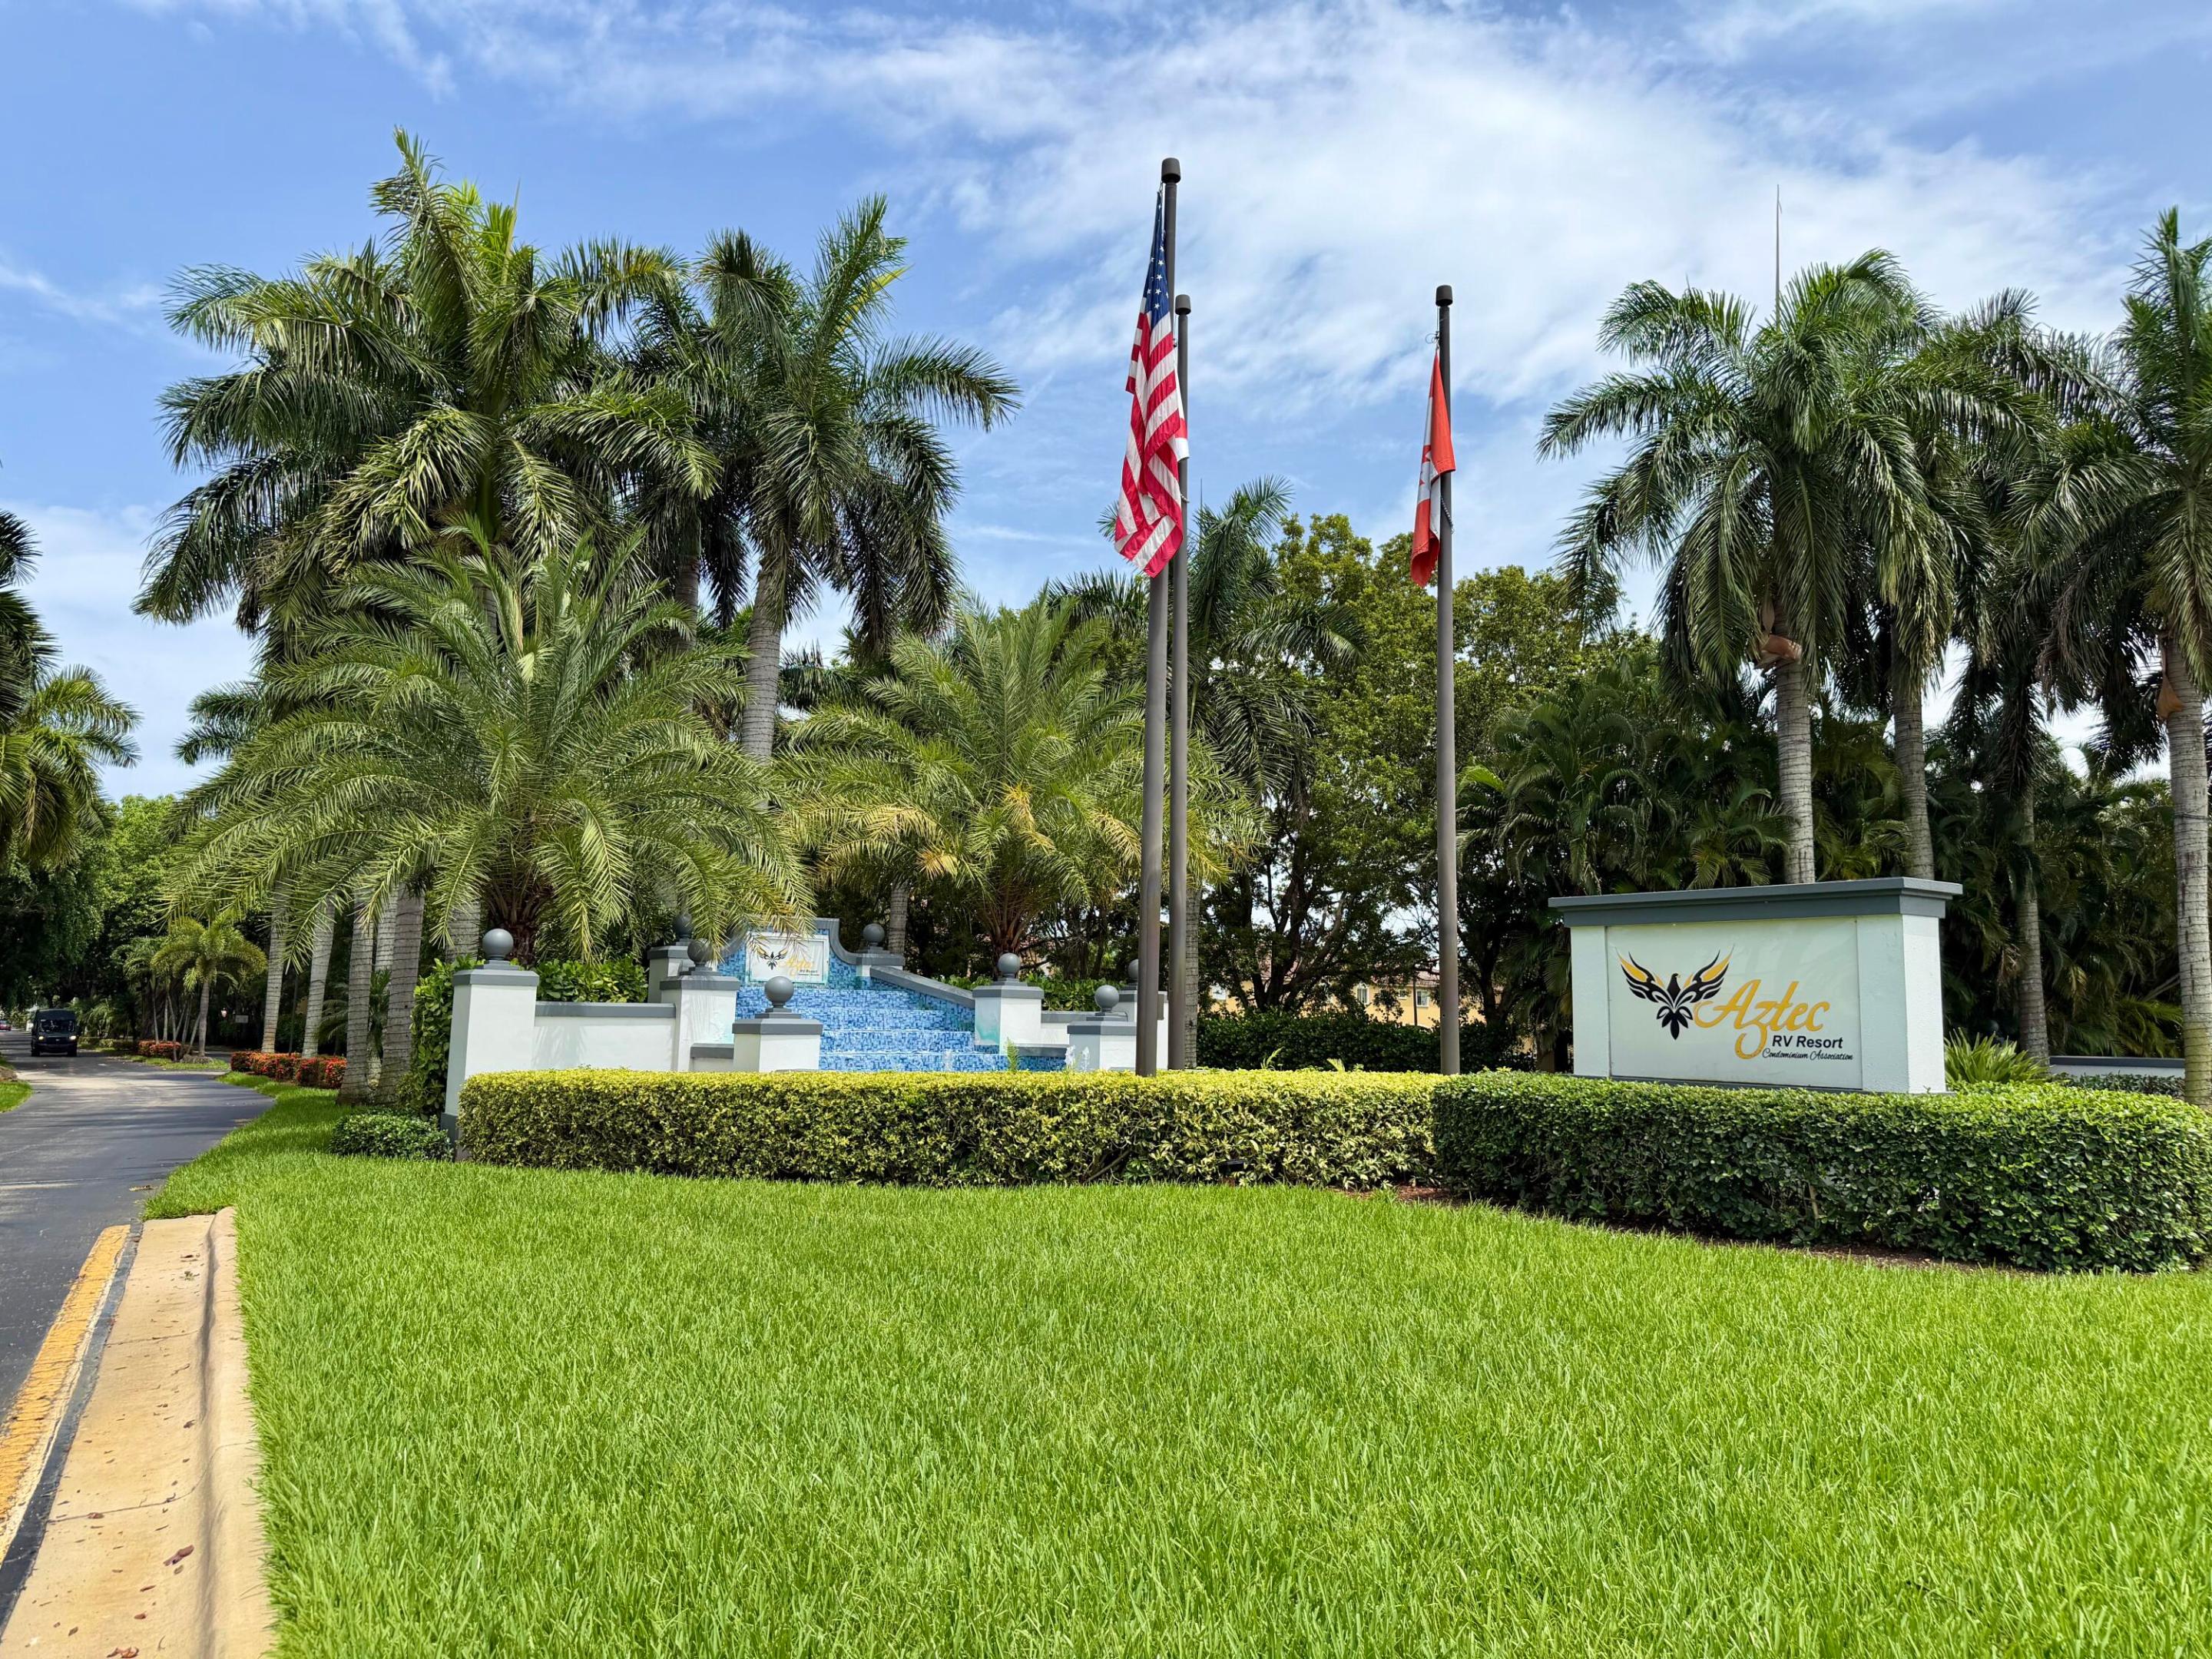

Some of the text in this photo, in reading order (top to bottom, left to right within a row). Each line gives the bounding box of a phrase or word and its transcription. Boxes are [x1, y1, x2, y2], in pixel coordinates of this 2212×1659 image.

[1694, 979, 1830, 1059] Aztec
[1772, 1035, 1843, 1048] RV Resort
[1762, 1048, 1853, 1061] Condominium Association
